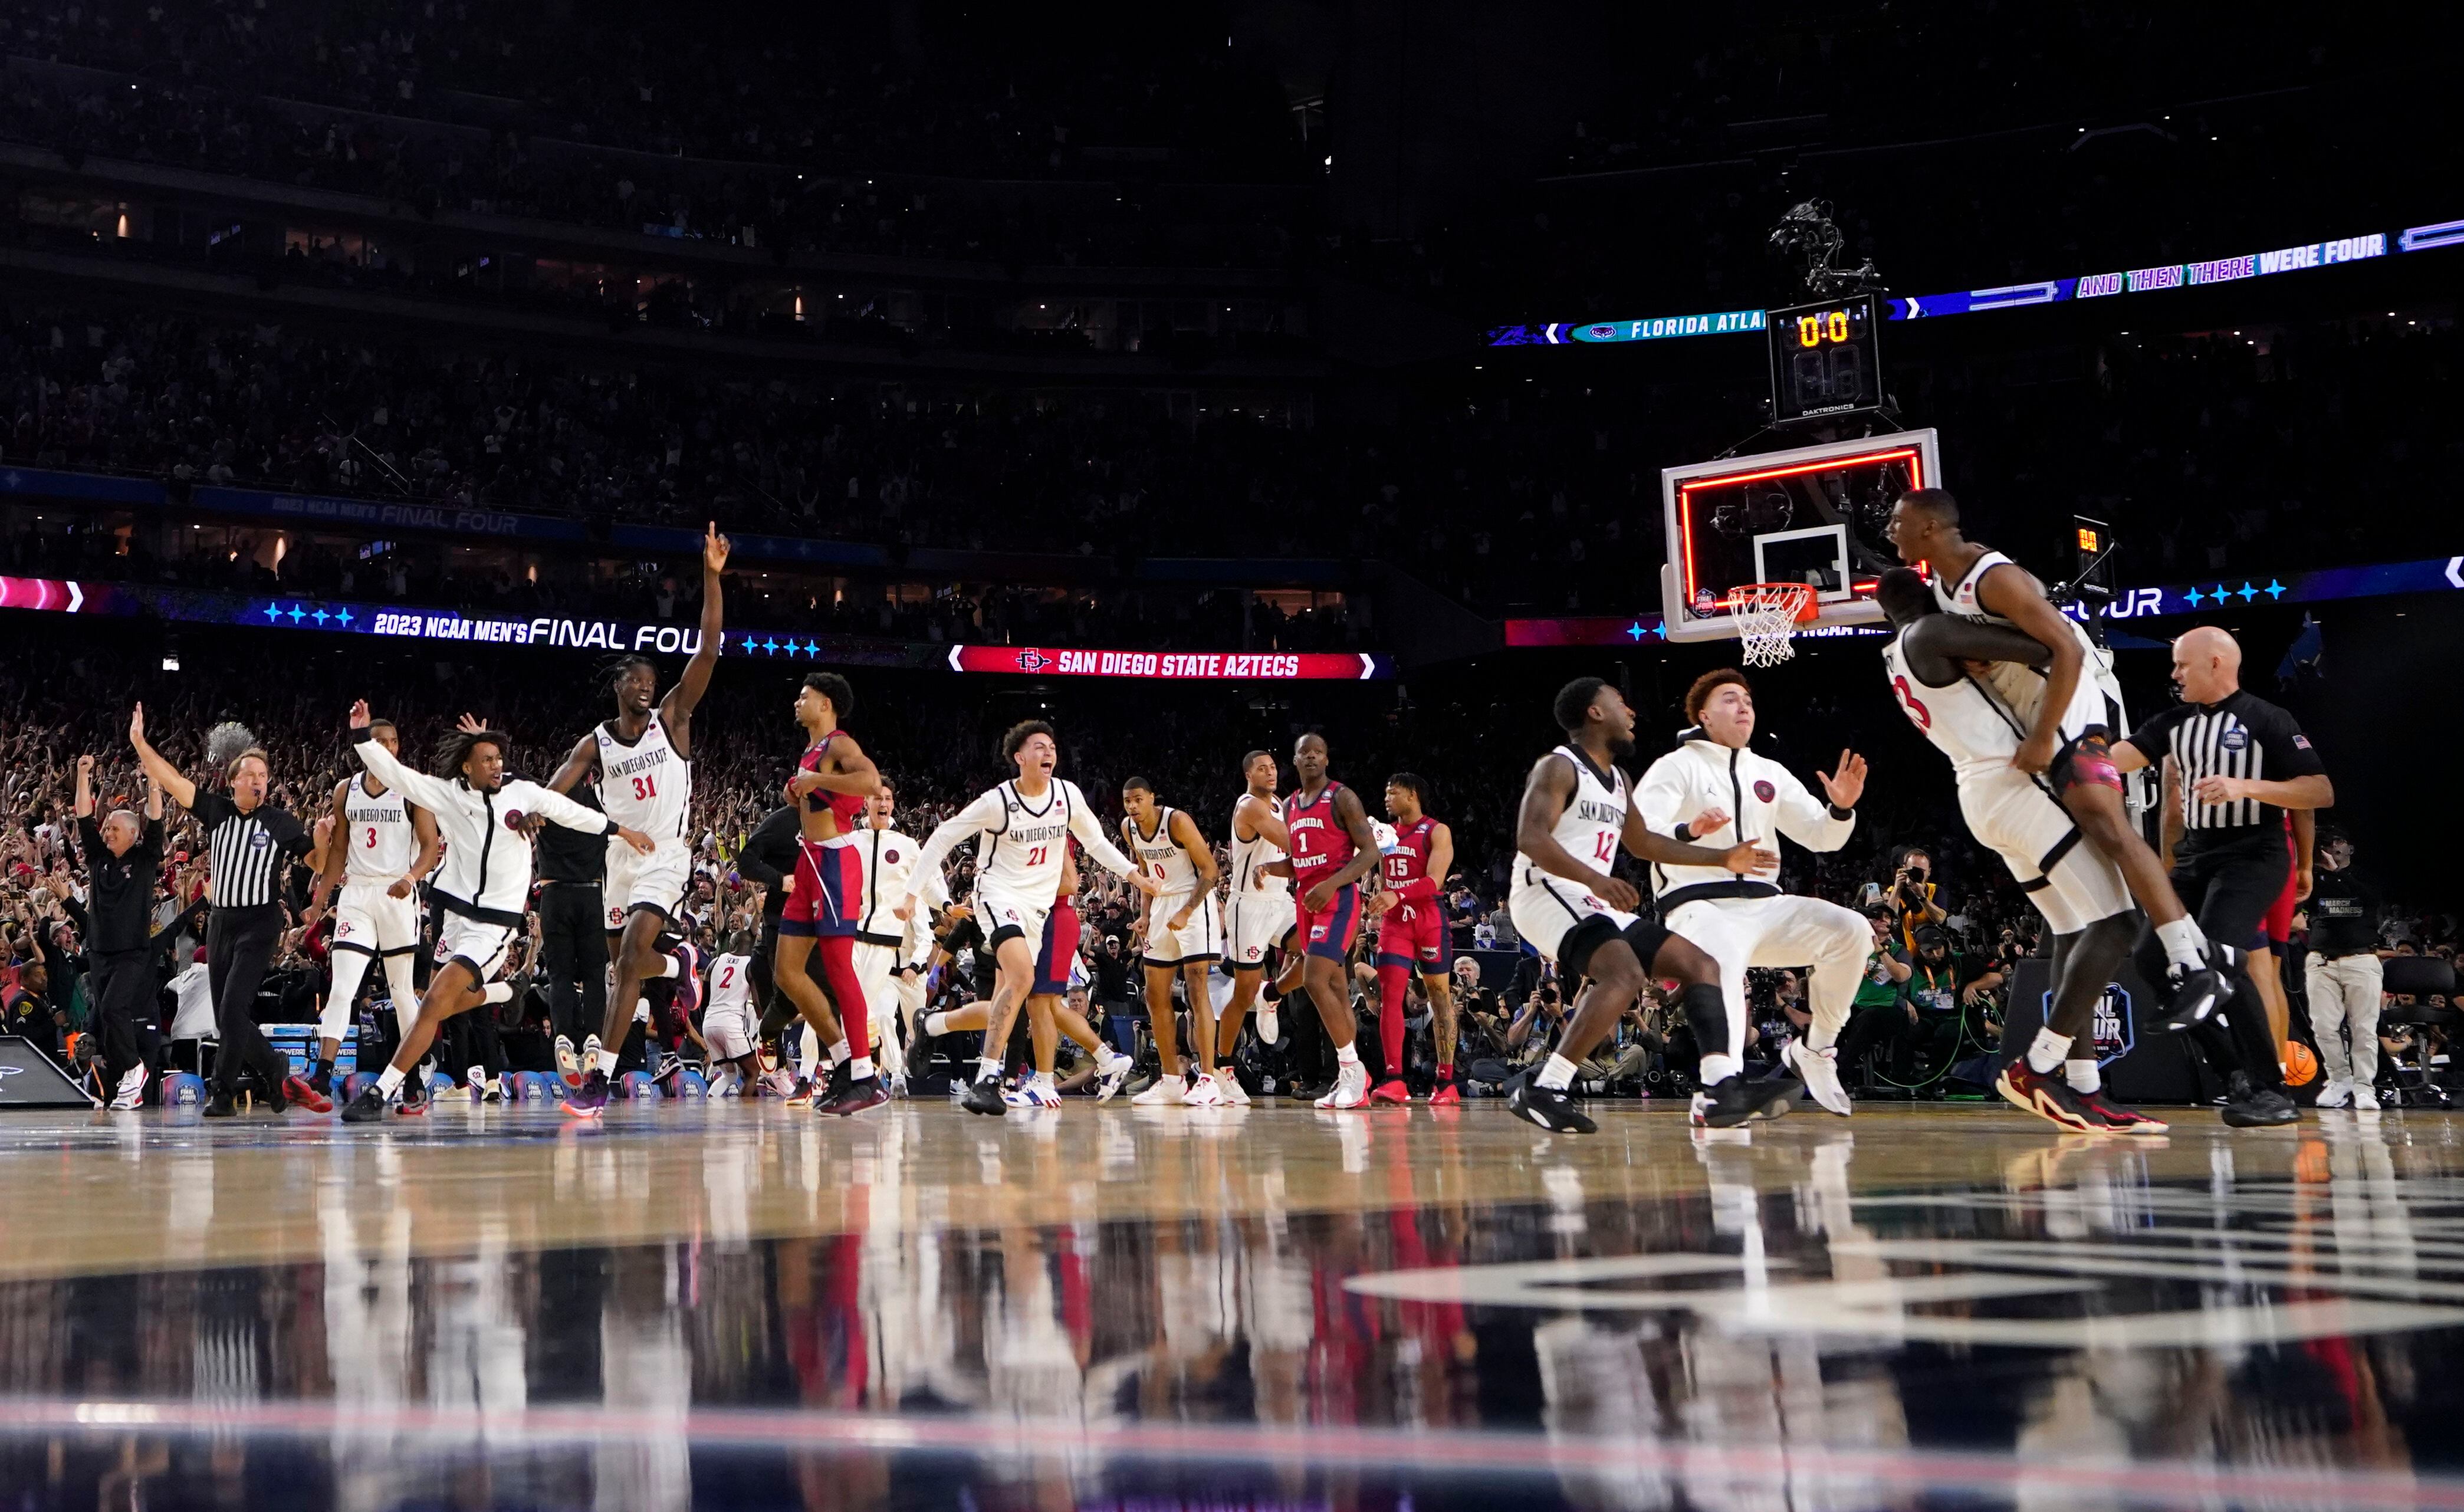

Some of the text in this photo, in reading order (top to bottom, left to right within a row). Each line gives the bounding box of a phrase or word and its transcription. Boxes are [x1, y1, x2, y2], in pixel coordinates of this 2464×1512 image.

[2077, 234, 2384, 298] AND THEN THERE WERE FOUR
[1631, 316, 1709, 338] FLORIDA
[1802, 403, 1854, 416] DAKTRONICS
[380, 505, 449, 528] FINAL
[456, 511, 518, 534] FOUR
[2061, 588, 2163, 620] OUR
[374, 614, 422, 636] 2023
[425, 617, 471, 639] NCAA
[474, 620, 527, 643] MEN'S
[528, 618, 626, 649] FINAL
[1059, 652, 1299, 676] SAN DIEGO STATE AZTECS
[608, 747, 667, 778] SAN DIEGO STATE
[632, 774, 656, 800] 31
[359, 808, 379, 822] DIEGO
[380, 809, 402, 823] STATE
[1578, 800, 1596, 821] SAN
[1010, 830, 1024, 843] SAN
[1026, 827, 1047, 842] DIEGO
[1290, 817, 1325, 834] FLORIDA
[367, 827, 376, 848] 3
[1299, 832, 1307, 853] 1
[1594, 831, 1614, 863] 12
[1026, 846, 1047, 866] 21
[1157, 847, 1177, 859] STATE
[1154, 863, 1165, 880] 0
[1388, 859, 1408, 876] 15
[2328, 906, 2363, 915] MADNESS
[719, 967, 734, 989] 2
[2092, 1017, 2121, 1040] UR
